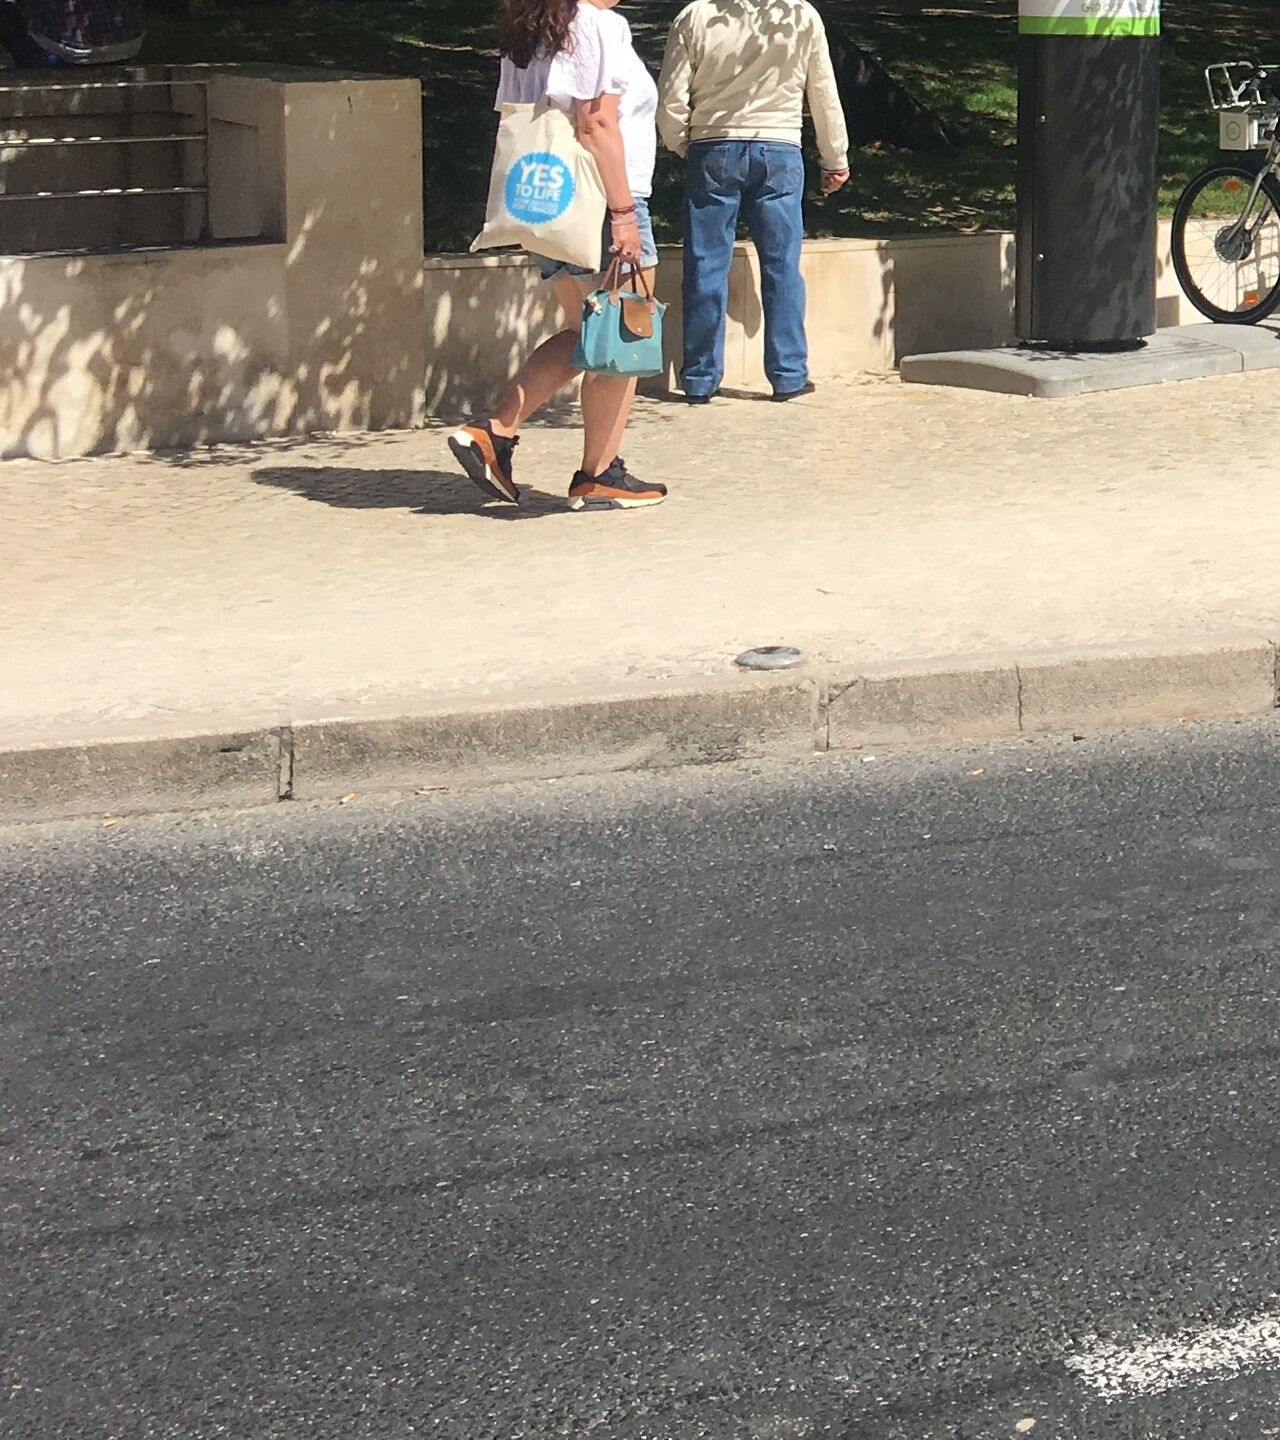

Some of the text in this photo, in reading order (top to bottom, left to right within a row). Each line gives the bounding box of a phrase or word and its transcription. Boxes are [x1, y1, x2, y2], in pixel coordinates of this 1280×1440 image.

[519, 160, 565, 189] YES
[515, 184, 562, 201] TO LIFE
